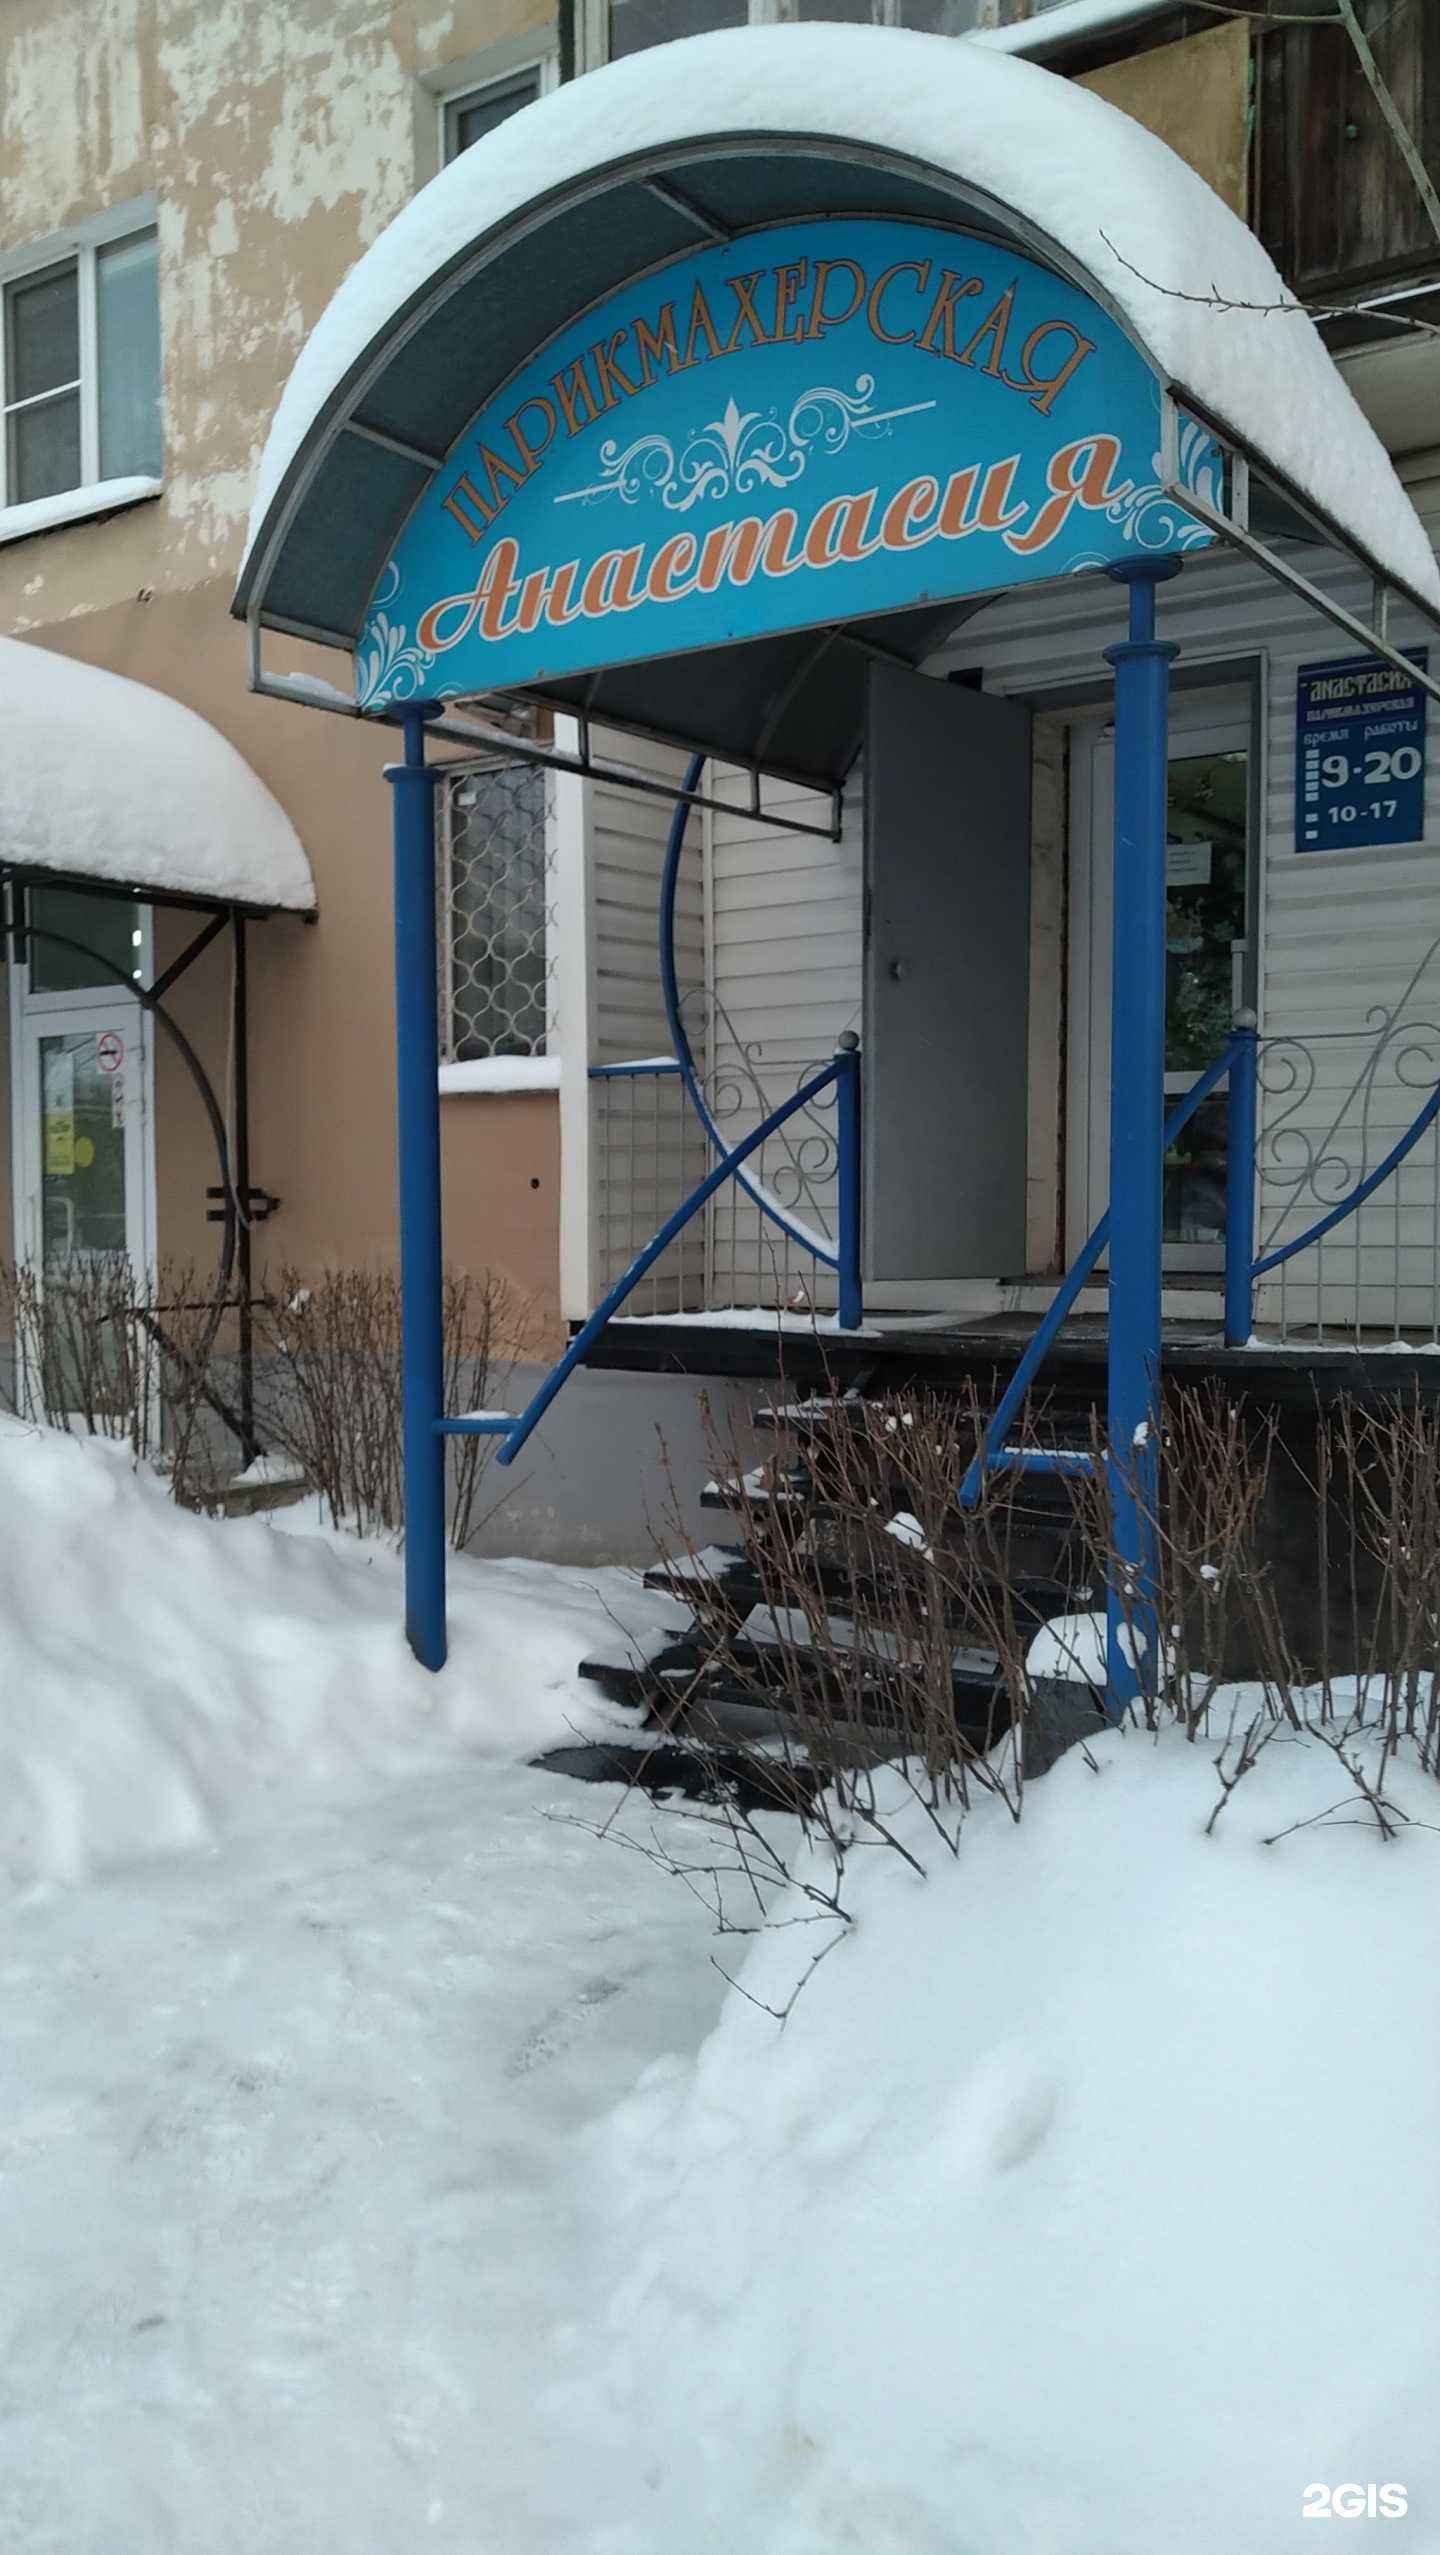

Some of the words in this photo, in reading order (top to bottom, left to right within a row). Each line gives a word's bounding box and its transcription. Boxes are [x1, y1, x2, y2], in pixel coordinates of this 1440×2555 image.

[443, 256, 1096, 546] ПАРИКМАХЕРСКАЯ
[414, 431, 1134, 653] Анастасия
[1321, 746, 1423, 788] 9-20
[1328, 800, 1397, 824] 10-17
